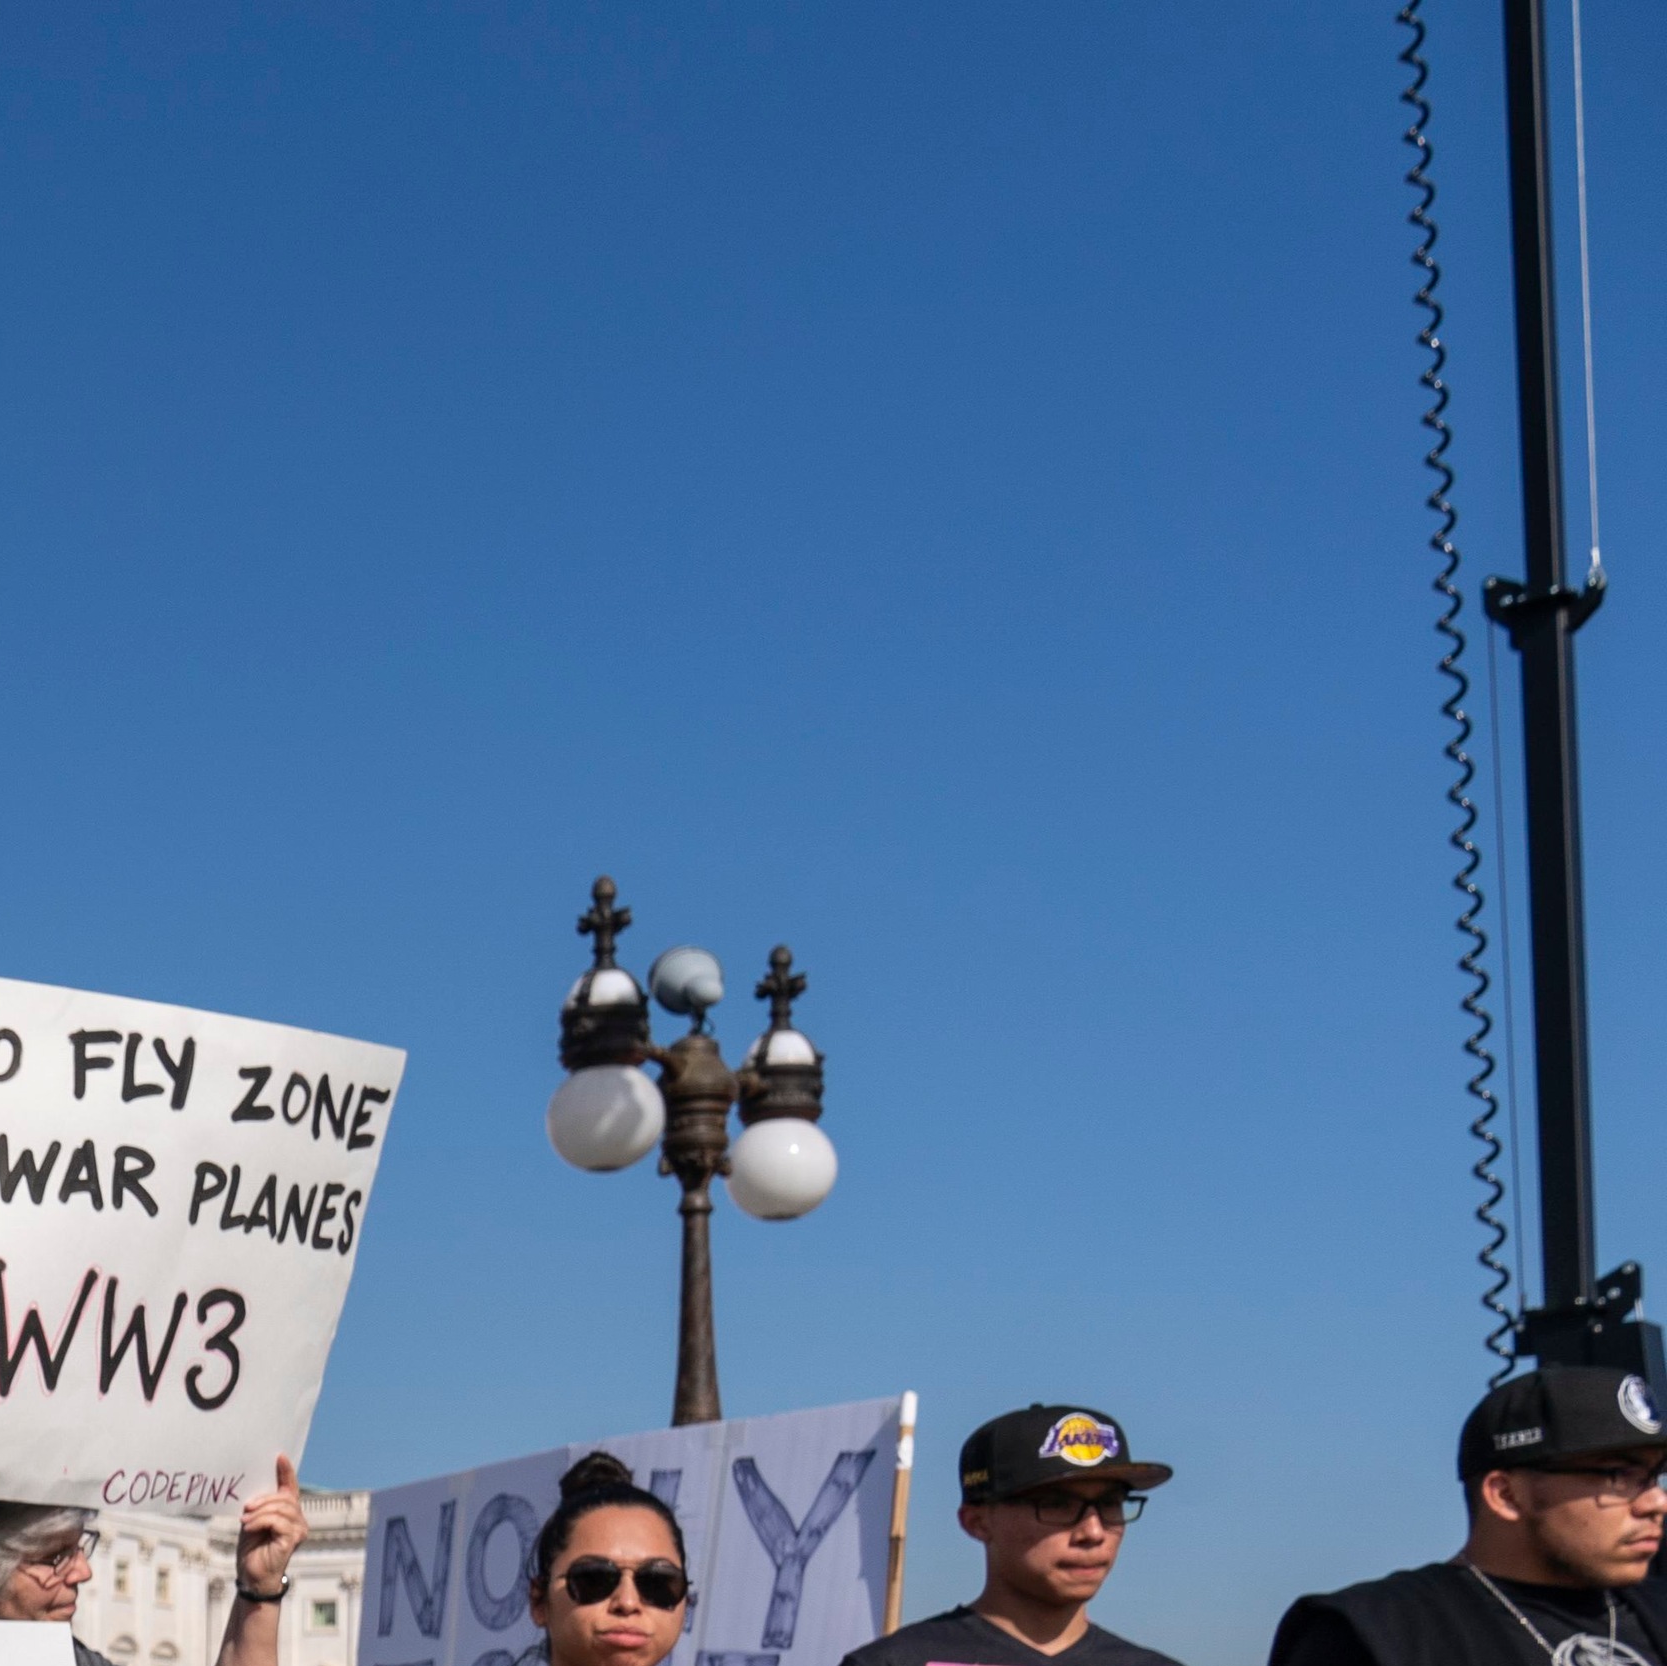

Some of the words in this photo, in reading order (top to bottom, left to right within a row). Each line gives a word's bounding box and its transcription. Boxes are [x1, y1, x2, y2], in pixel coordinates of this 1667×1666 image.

[69, 1028, 197, 1111] FLY
[231, 1065, 391, 1152] ZONE
[189, 1161, 364, 1256] PLANES
[102, 1469, 246, 1506] CODEPINK
